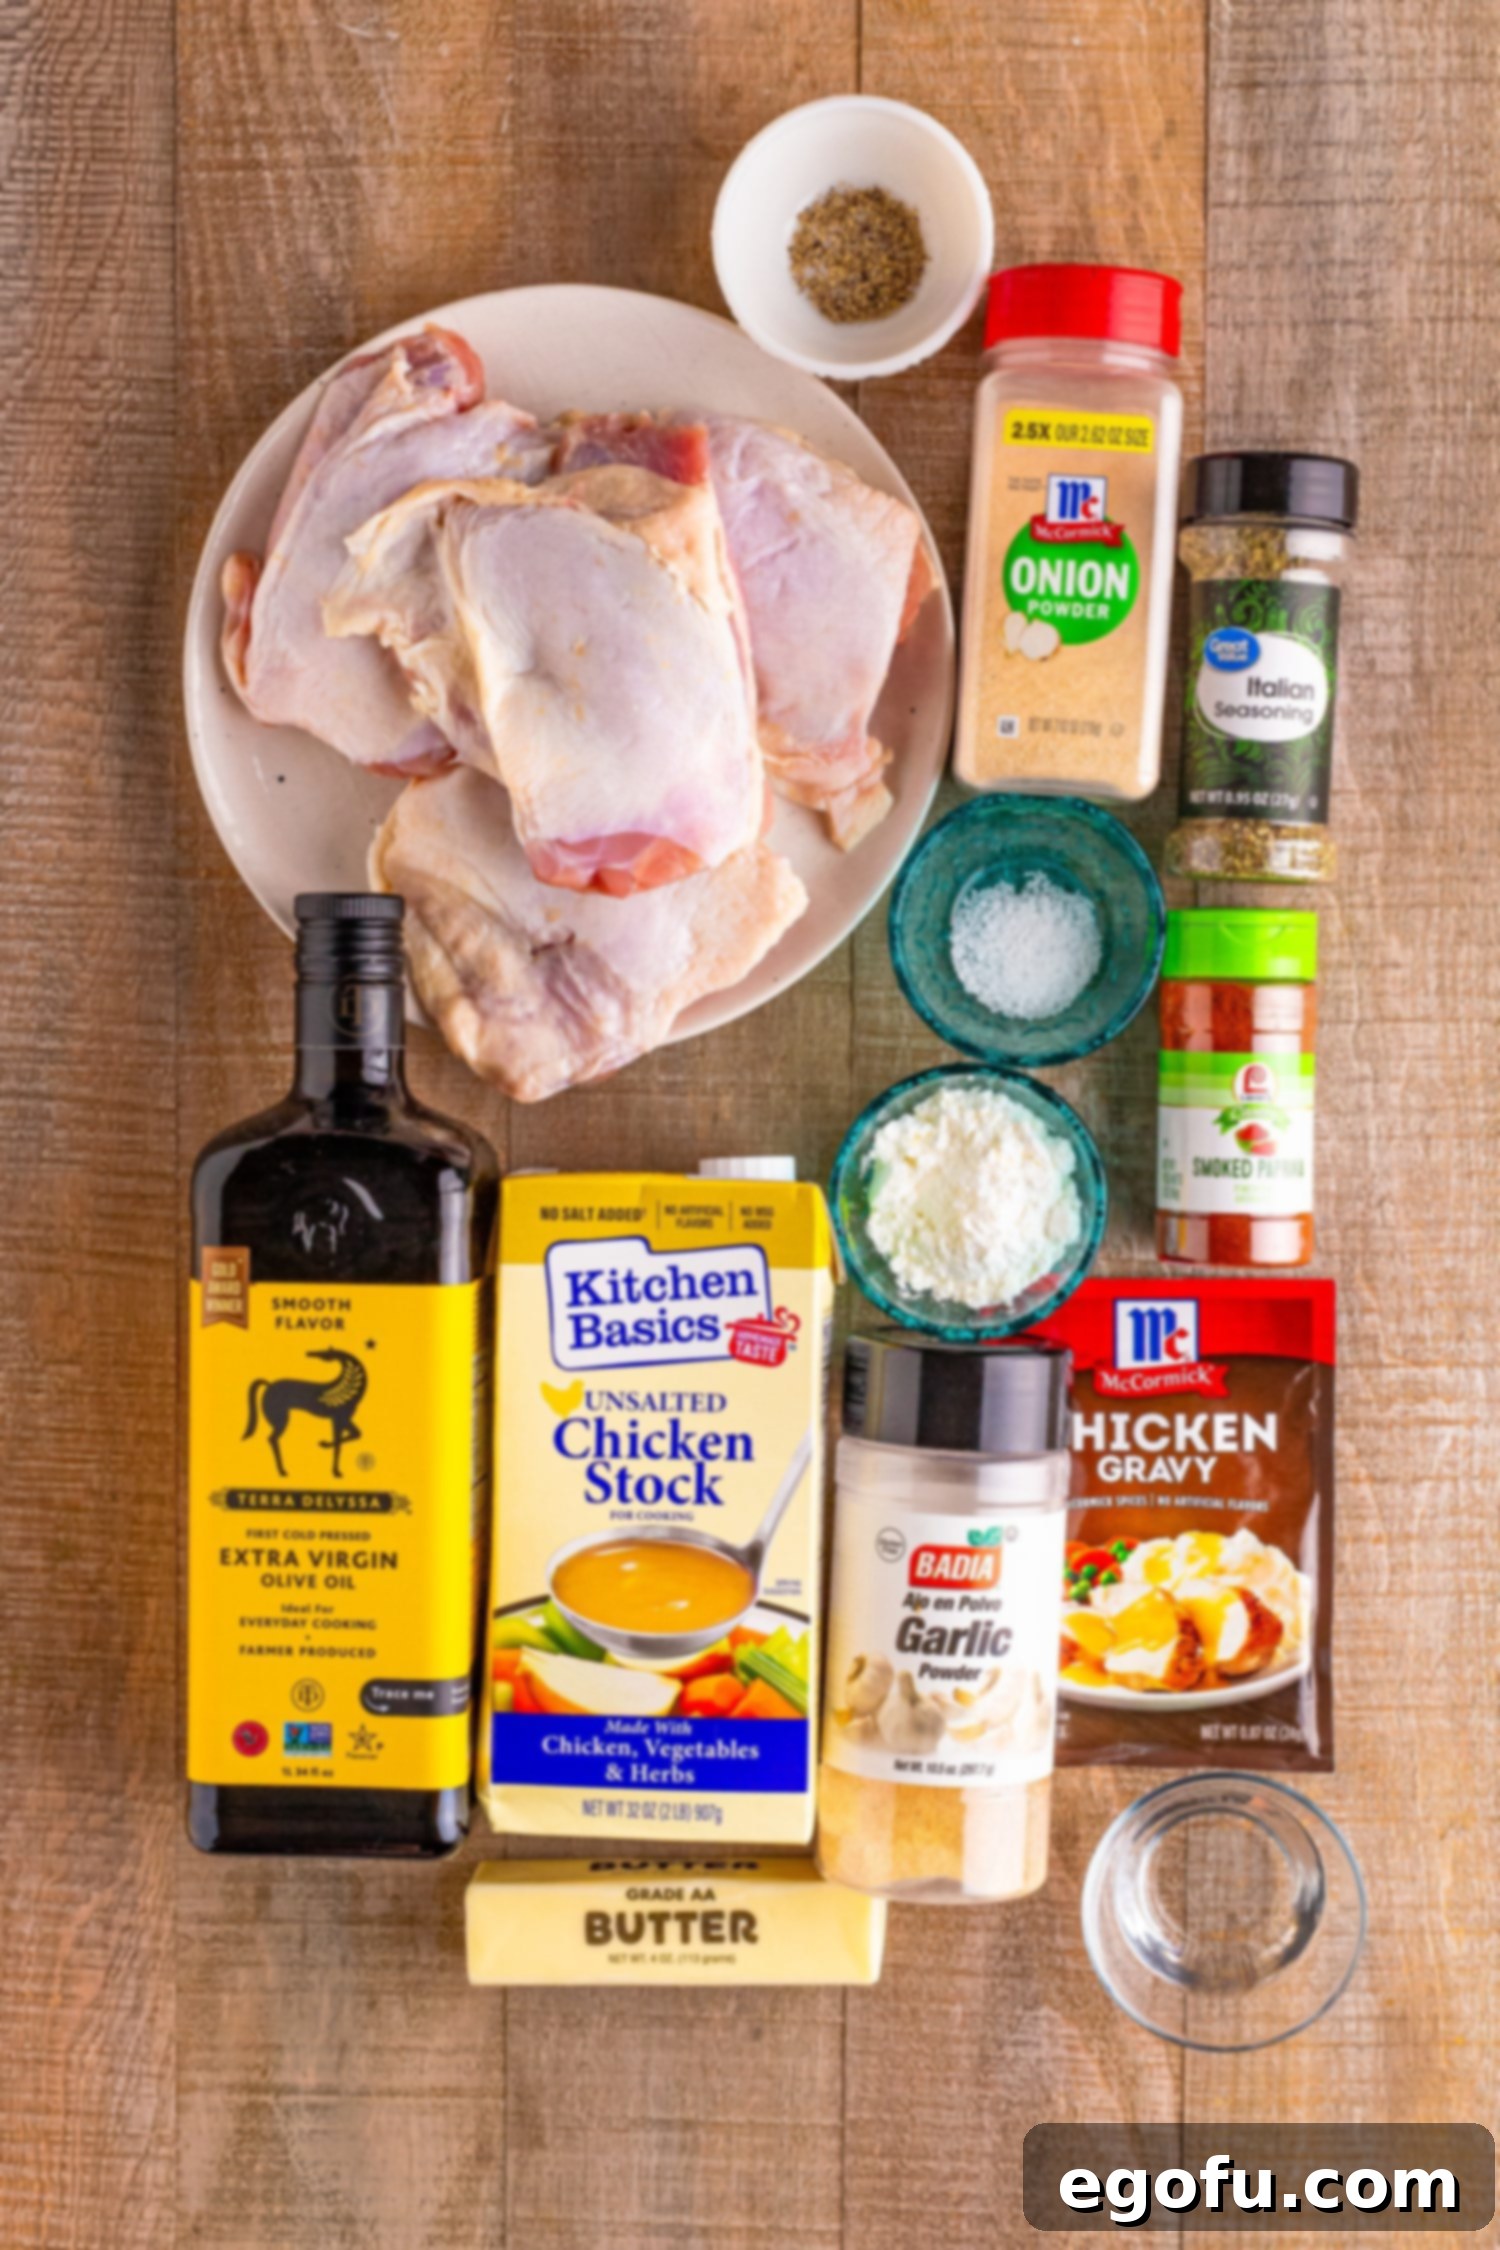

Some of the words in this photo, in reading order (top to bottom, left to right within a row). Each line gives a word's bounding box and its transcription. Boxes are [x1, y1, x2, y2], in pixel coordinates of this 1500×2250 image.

[1011, 421, 1051, 441] 2.5X
[1125, 428, 1150, 447] SIZE
[1010, 557, 1130, 600] ONION
[1028, 599, 1110, 619] POWDER
[1247, 677, 1315, 700] Italian
[1214, 702, 1314, 725] Seasoning
[1193, 1156, 1252, 1179] SMOKED
[540, 1207, 558, 1221] NO
[562, 1207, 594, 1221] SALT
[564, 1264, 759, 1309] Kitchen
[272, 1297, 352, 1312] SMOOTH
[275, 1316, 346, 1330] FLAVOR
[567, 1308, 721, 1350] Basics
[1100, 1366, 1213, 1393] McCormick
[583, 1390, 727, 1414] UNSALTED
[552, 1416, 754, 1462] Chicken
[1072, 1412, 1278, 1452] HICKEN
[1096, 1456, 1217, 1484] GRAVY
[583, 1460, 725, 1506] Stock
[237, 1491, 296, 1508] TERRA
[301, 1493, 382, 1509] DELYSSA
[609, 1510, 634, 1520] FOR
[637, 1511, 694, 1522] COOKING
[246, 1529, 278, 1540] FIRST
[283, 1529, 316, 1540] COLD
[319, 1530, 372, 1542] PRESSED
[219, 1548, 300, 1567] EXTRA
[308, 1550, 399, 1570] VIRGIN
[915, 1551, 995, 1580] BADIA
[260, 1573, 317, 1589] OLIVE
[324, 1574, 355, 1590] OIL
[281, 1603, 311, 1614] Ideal
[902, 1592, 930, 1611] Ajo
[933, 1597, 955, 1611] en
[959, 1595, 1002, 1612] Polvo
[239, 1617, 307, 1629] EVERYDAY
[312, 1618, 376, 1630] COOKING
[895, 1616, 1013, 1657] Garlic
[239, 1645, 294, 1657] FARMER
[299, 1647, 376, 1659] PRODUCED
[918, 1662, 982, 1681] Powder
[371, 1686, 409, 1700] Trace
[413, 1689, 435, 1700] me
[604, 1720, 650, 1736] Made
[654, 1720, 692, 1736] With
[541, 1735, 638, 1758] Chicken,
[643, 1737, 759, 1764] Vegetables
[605, 1765, 624, 1782] &
[630, 1764, 695, 1784] Herbs
[582, 1799, 602, 1817] NET
[589, 1860, 760, 1872] BUTTER
[626, 1888, 684, 1902] GRADE
[690, 1888, 716, 1902] AA
[584, 1910, 759, 1946] BUTTER
